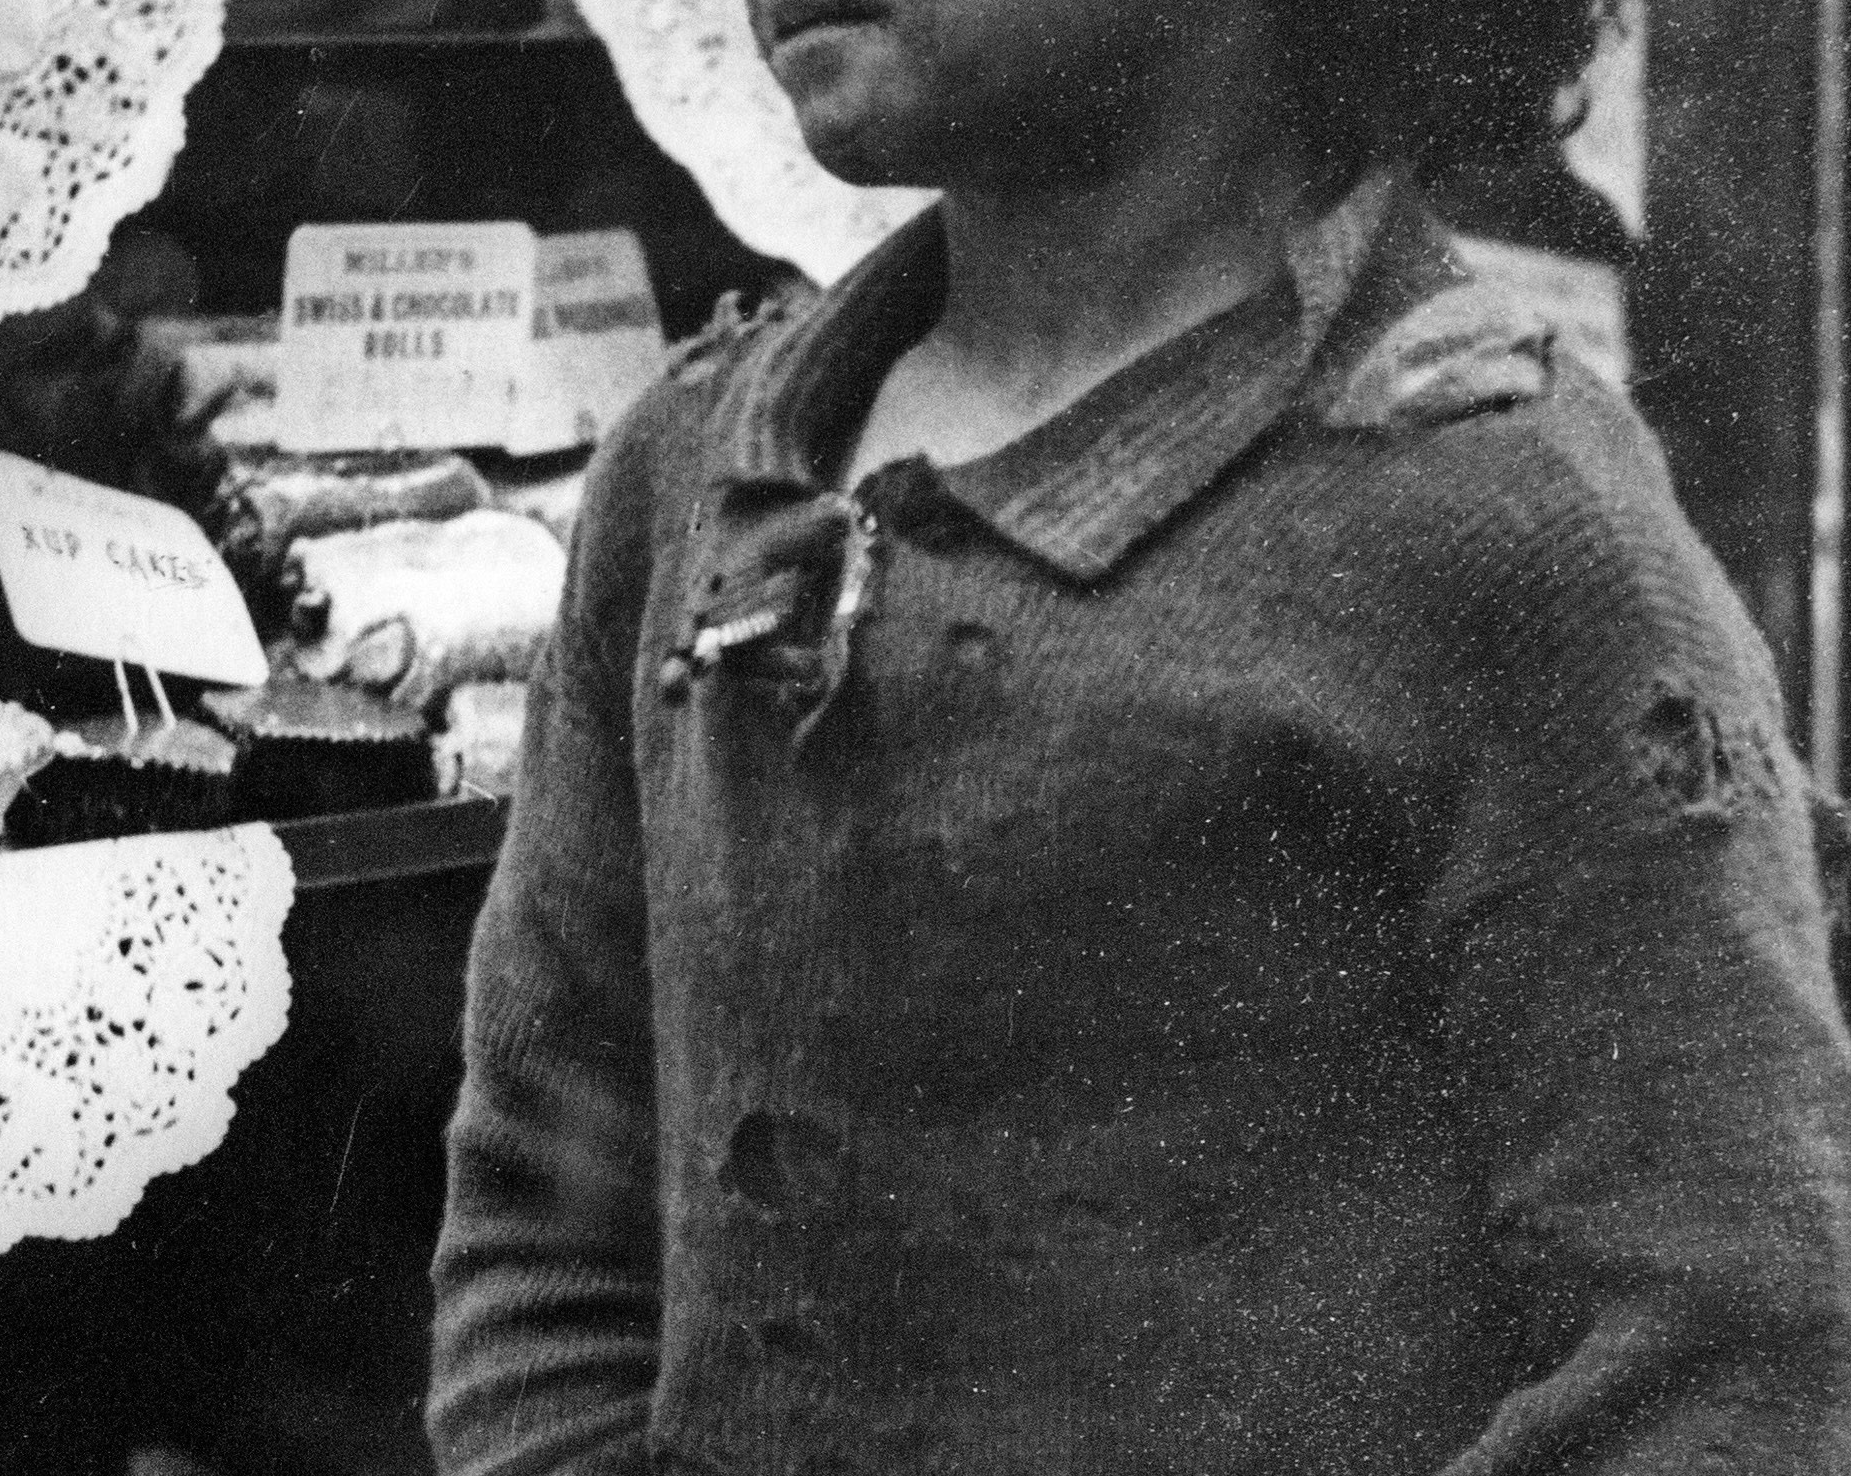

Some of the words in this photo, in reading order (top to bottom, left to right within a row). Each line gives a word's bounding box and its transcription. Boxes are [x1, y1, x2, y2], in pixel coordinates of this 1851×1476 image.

[344, 248, 475, 276] MILLER'S
[392, 290, 519, 323] CHOCOLATE
[363, 329, 446, 362] ROLLS
[105, 538, 210, 590] CAKES
